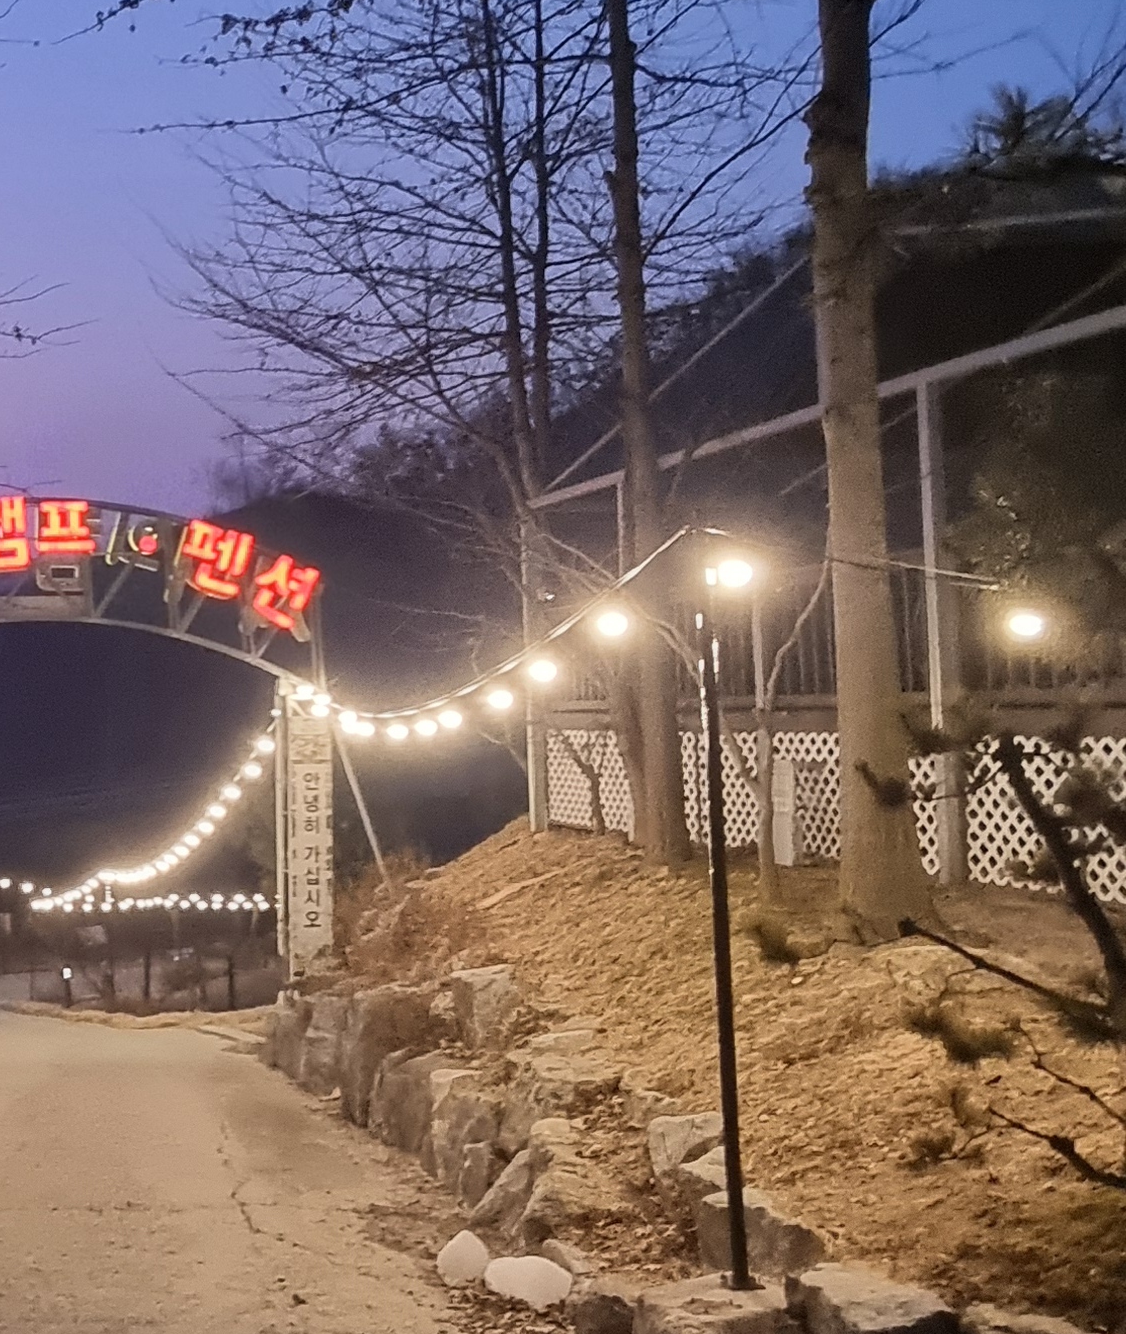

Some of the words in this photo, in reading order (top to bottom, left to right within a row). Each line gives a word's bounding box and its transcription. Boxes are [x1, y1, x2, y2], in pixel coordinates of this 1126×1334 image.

[182, 519, 320, 629] 펜션
[303, 772, 320, 834] 안녕히
[303, 845, 321, 928] 가십시오
